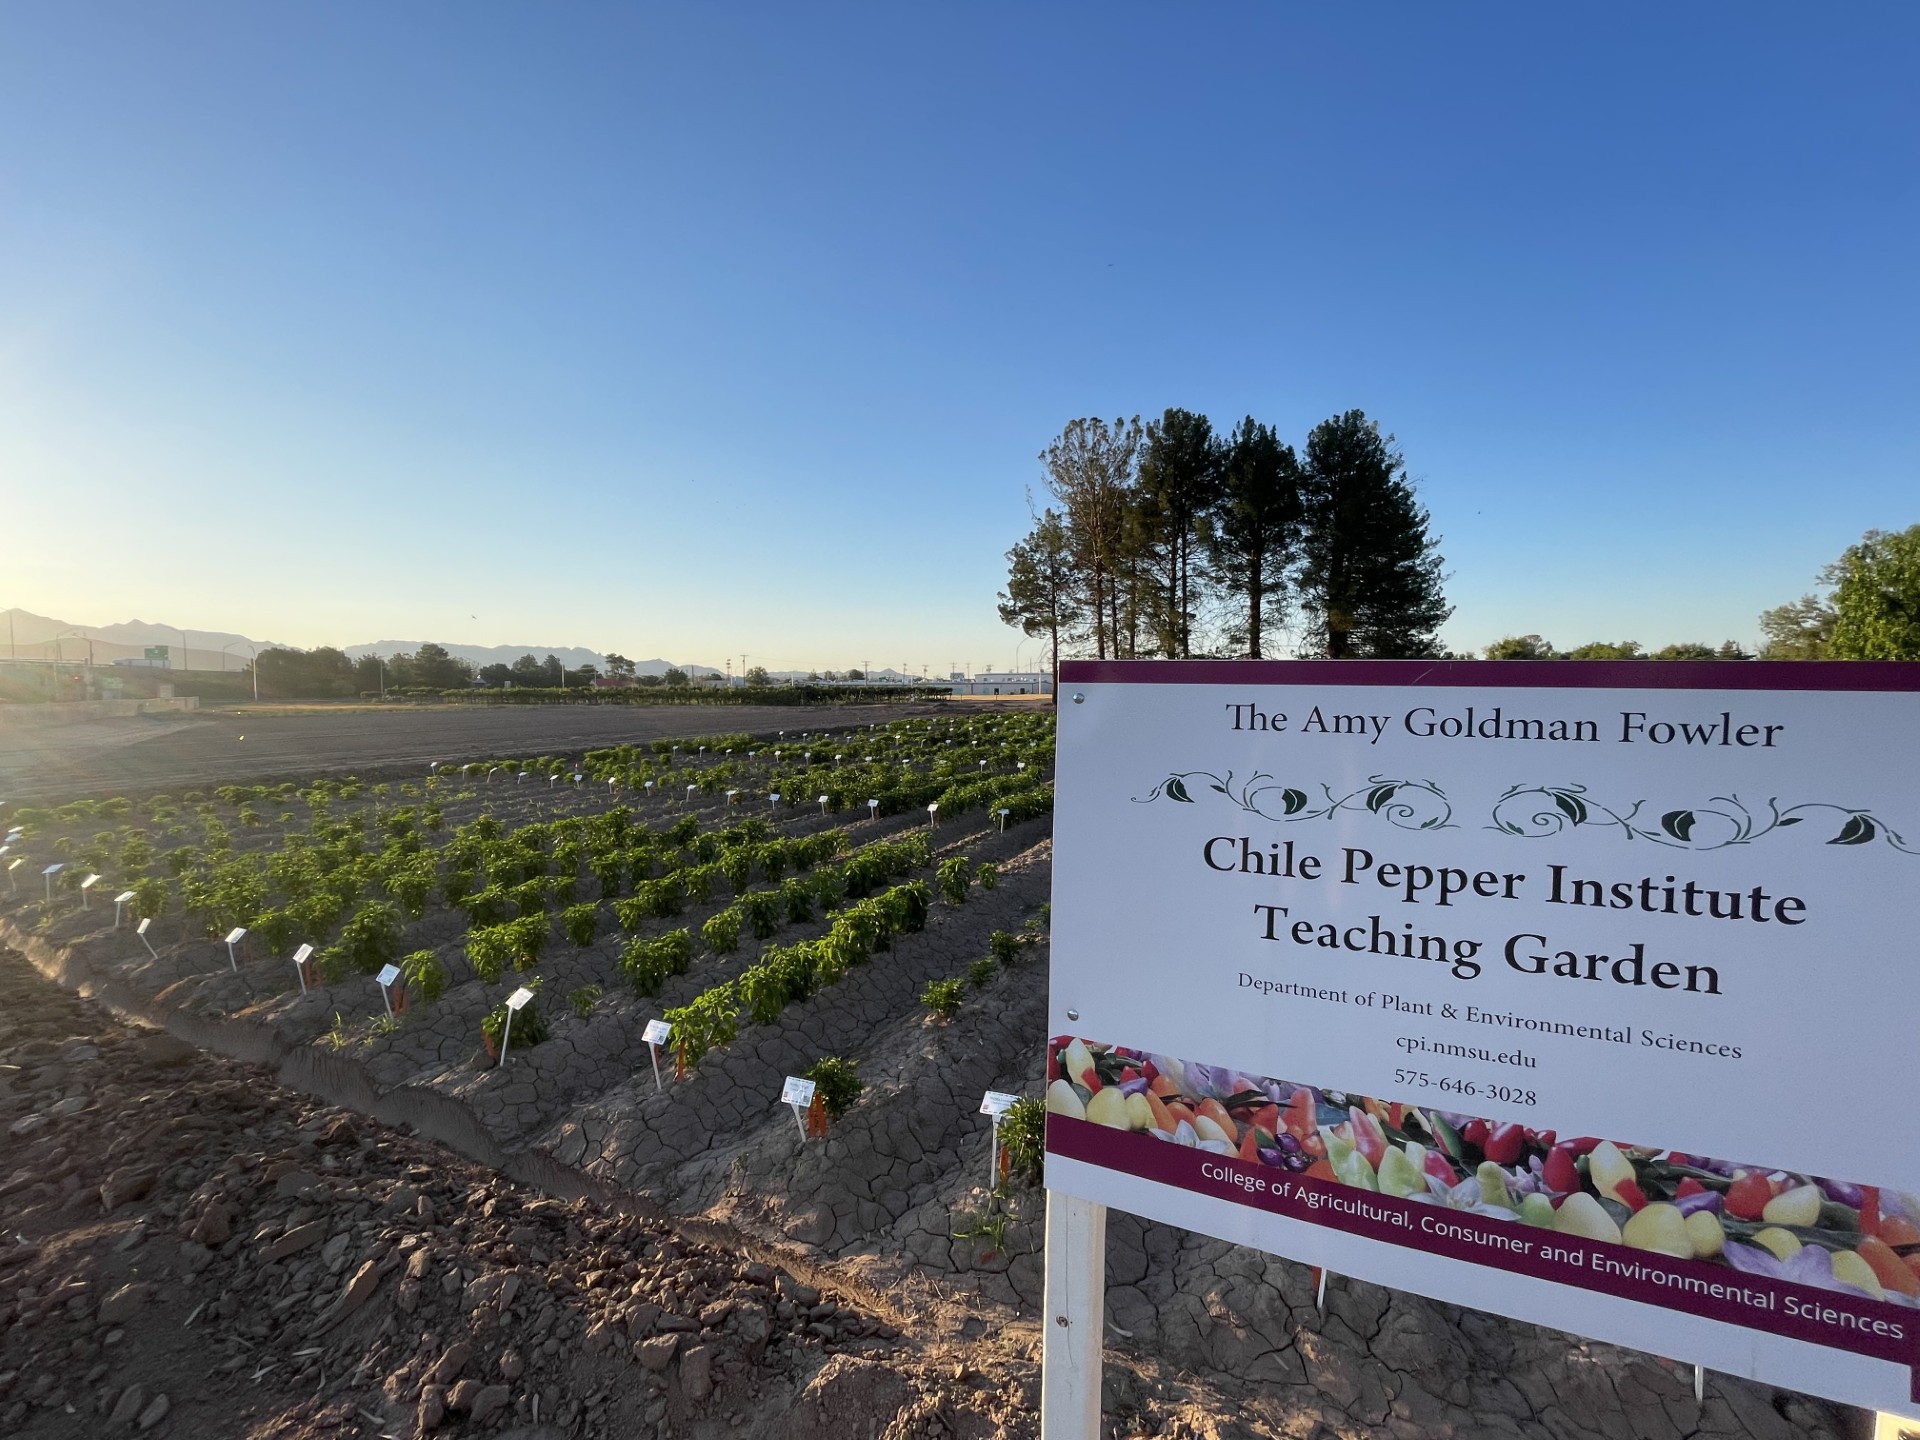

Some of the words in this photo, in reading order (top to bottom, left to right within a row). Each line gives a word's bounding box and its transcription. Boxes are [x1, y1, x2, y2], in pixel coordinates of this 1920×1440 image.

[1226, 703, 1287, 732] The
[1301, 706, 1391, 746] Amy
[1405, 707, 1601, 741] Goldman
[1619, 712, 1785, 747] Fowler
[1204, 837, 1322, 881] Chile
[1341, 848, 1526, 907] Pepper
[1545, 865, 1807, 926] Institute
[1254, 904, 1484, 981] Teaching
[1505, 934, 1723, 996] Garden
[1239, 973, 1348, 1004] Department
[1355, 991, 1377, 1006] of
[1382, 994, 1433, 1015] Plant
[1440, 1003, 1459, 1019] &
[1466, 1006, 1632, 1044] Environmental
[1641, 1030, 1742, 1059] Sciences
[1396, 1037, 1537, 1069] cpi.nmsu.edu
[1394, 1069, 1537, 1106] 575-646-3028
[1201, 1163, 1266, 1192] College
[1271, 1181, 1291, 1197] of
[1294, 1186, 1413, 1230] Agricultural,
[1421, 1216, 1534, 1254] Consumer
[1541, 1246, 1583, 1266] and
[1593, 1253, 1775, 1310] Environmental
[1785, 1297, 1903, 1339] Sciences
